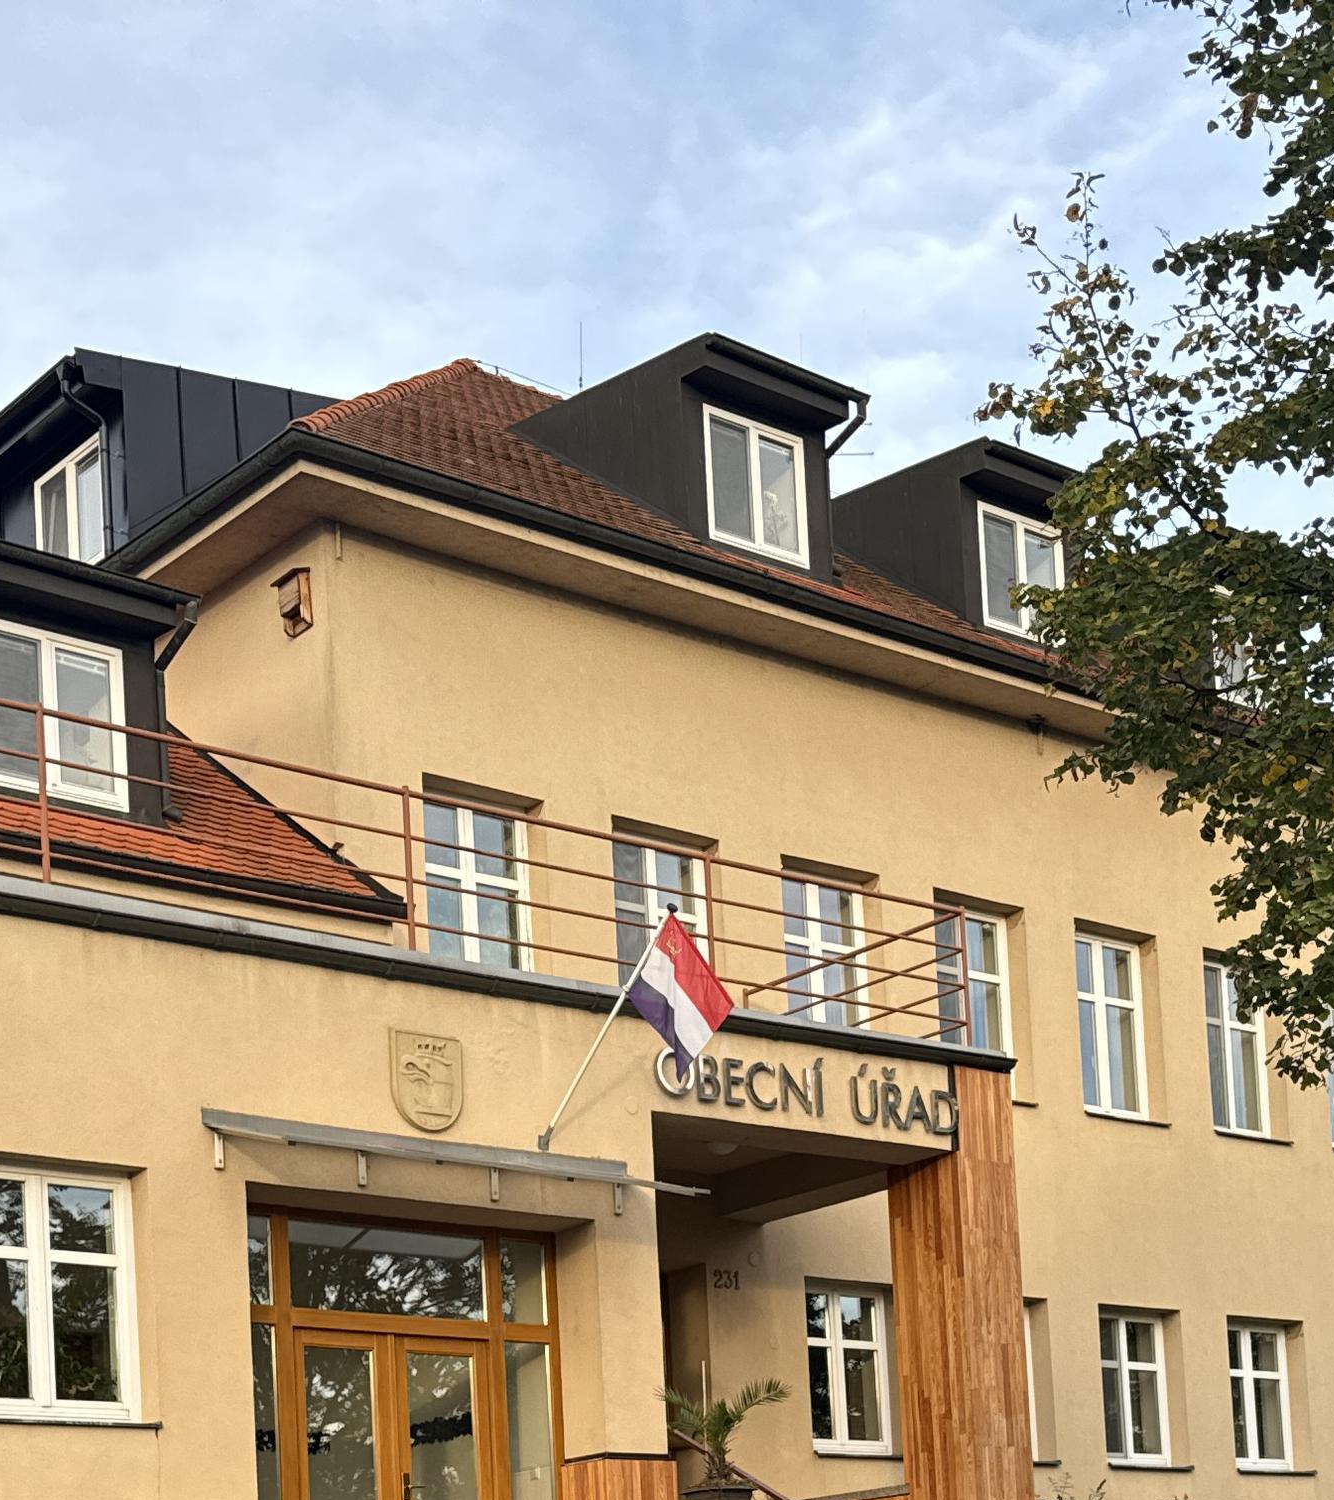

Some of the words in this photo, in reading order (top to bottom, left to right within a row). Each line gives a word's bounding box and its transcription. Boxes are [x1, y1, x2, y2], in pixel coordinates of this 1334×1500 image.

[655, 1047, 824, 1117] OBECNÍ
[850, 1063, 959, 1136] ÚŘAD
[713, 1269, 740, 1290] 231
